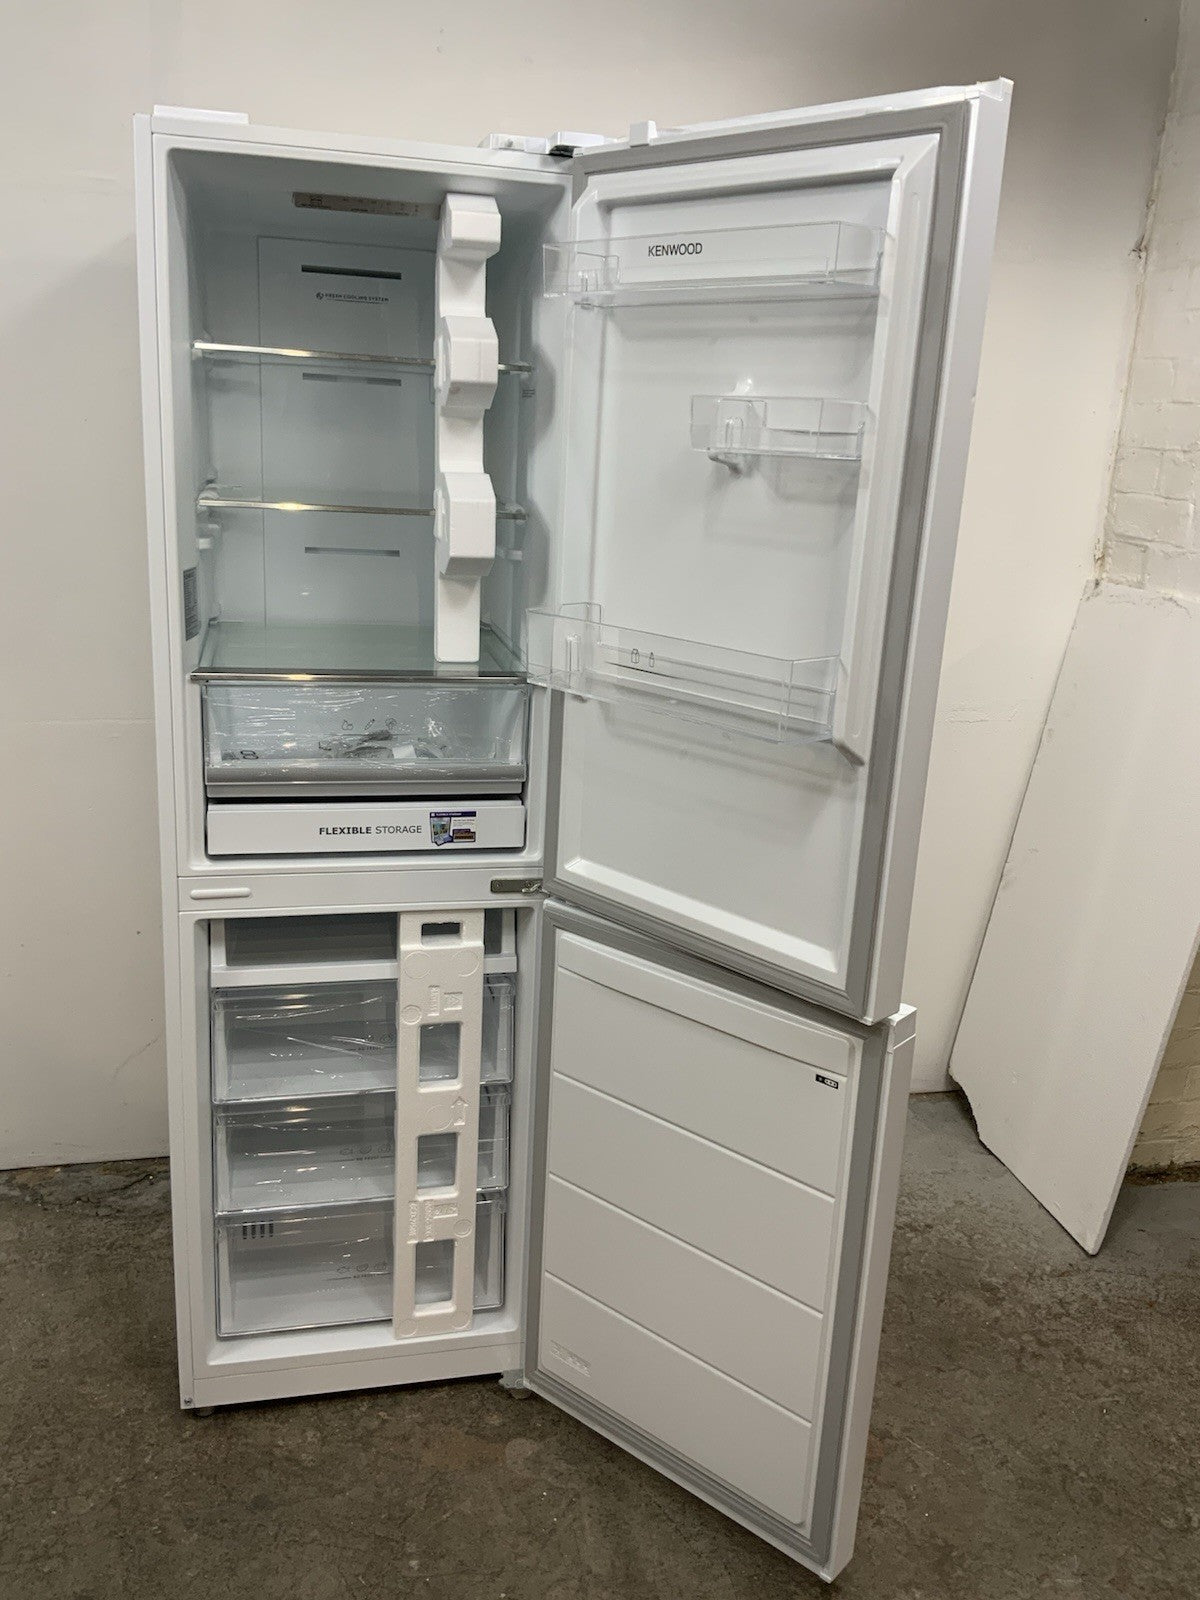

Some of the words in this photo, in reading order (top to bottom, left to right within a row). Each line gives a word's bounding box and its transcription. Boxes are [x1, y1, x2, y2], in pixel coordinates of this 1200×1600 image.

[648, 243, 703, 257] KENWOOD
[319, 826, 372, 836] FLEXIBLE
[375, 825, 423, 834] STORAGE
